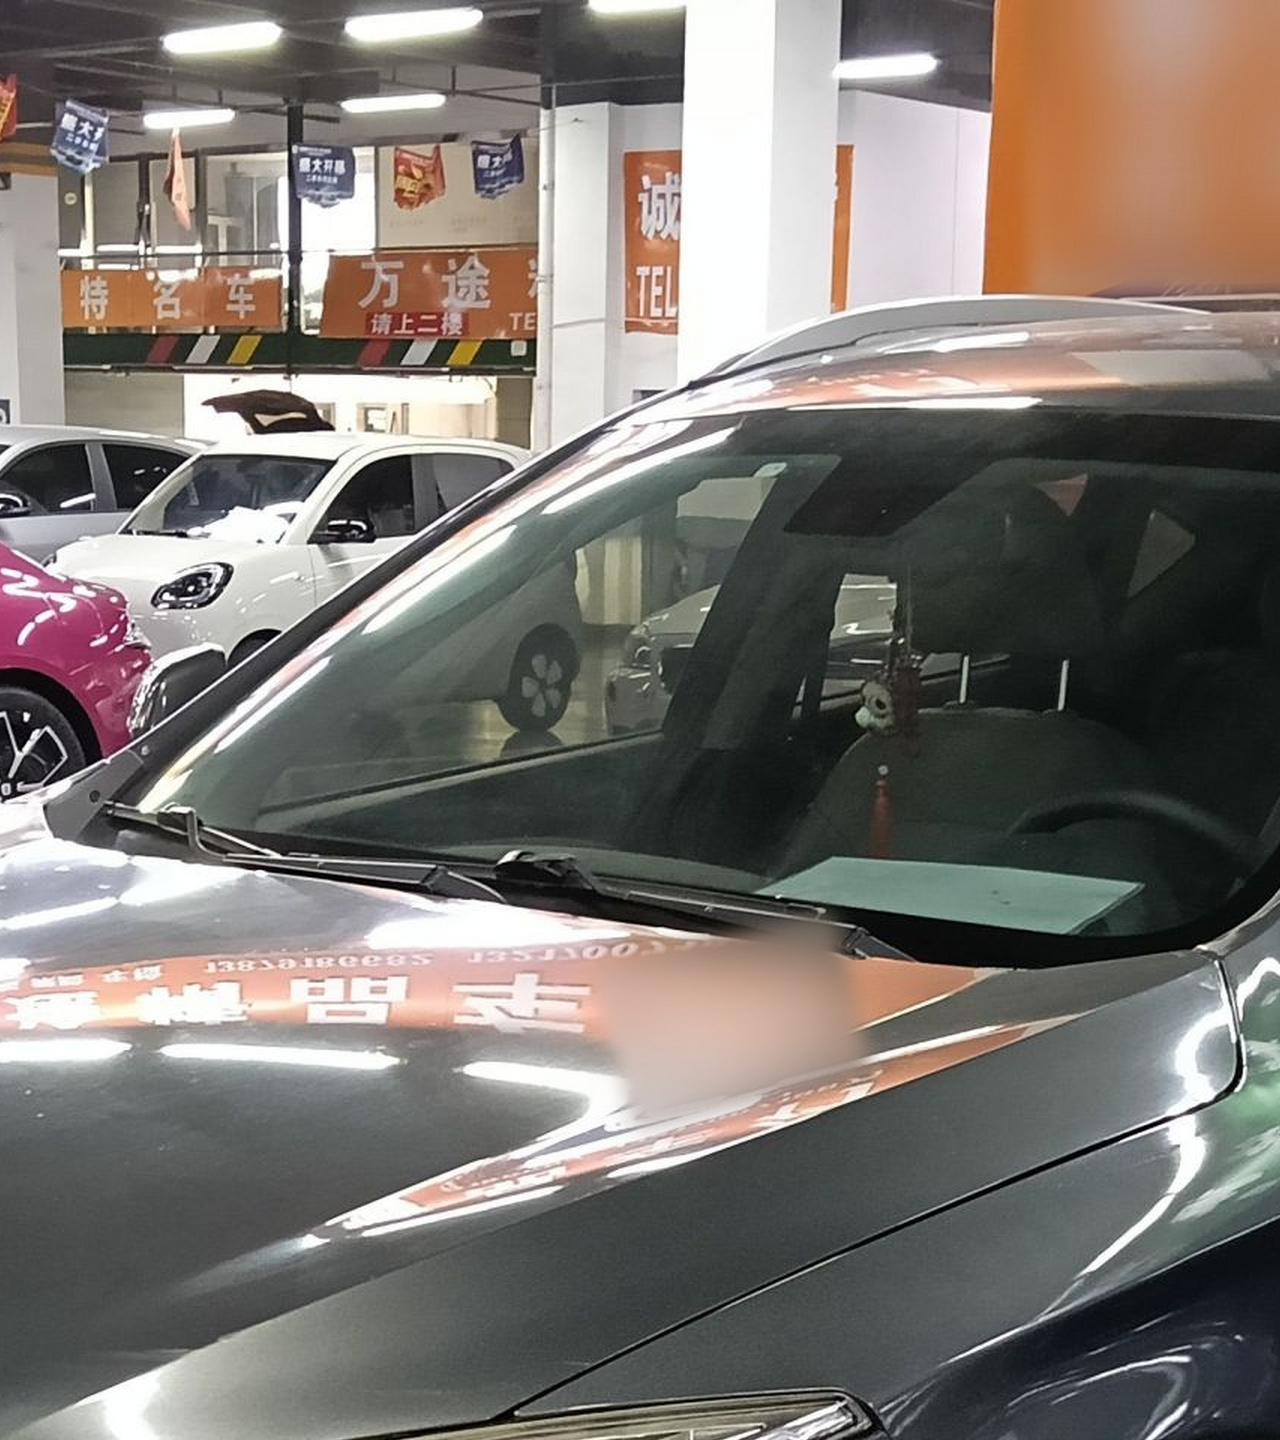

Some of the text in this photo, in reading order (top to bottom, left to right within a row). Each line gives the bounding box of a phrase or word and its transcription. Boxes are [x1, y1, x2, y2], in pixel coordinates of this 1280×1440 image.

[636, 266, 677, 317] TEL
[370, 311, 465, 336] 请上二楼
